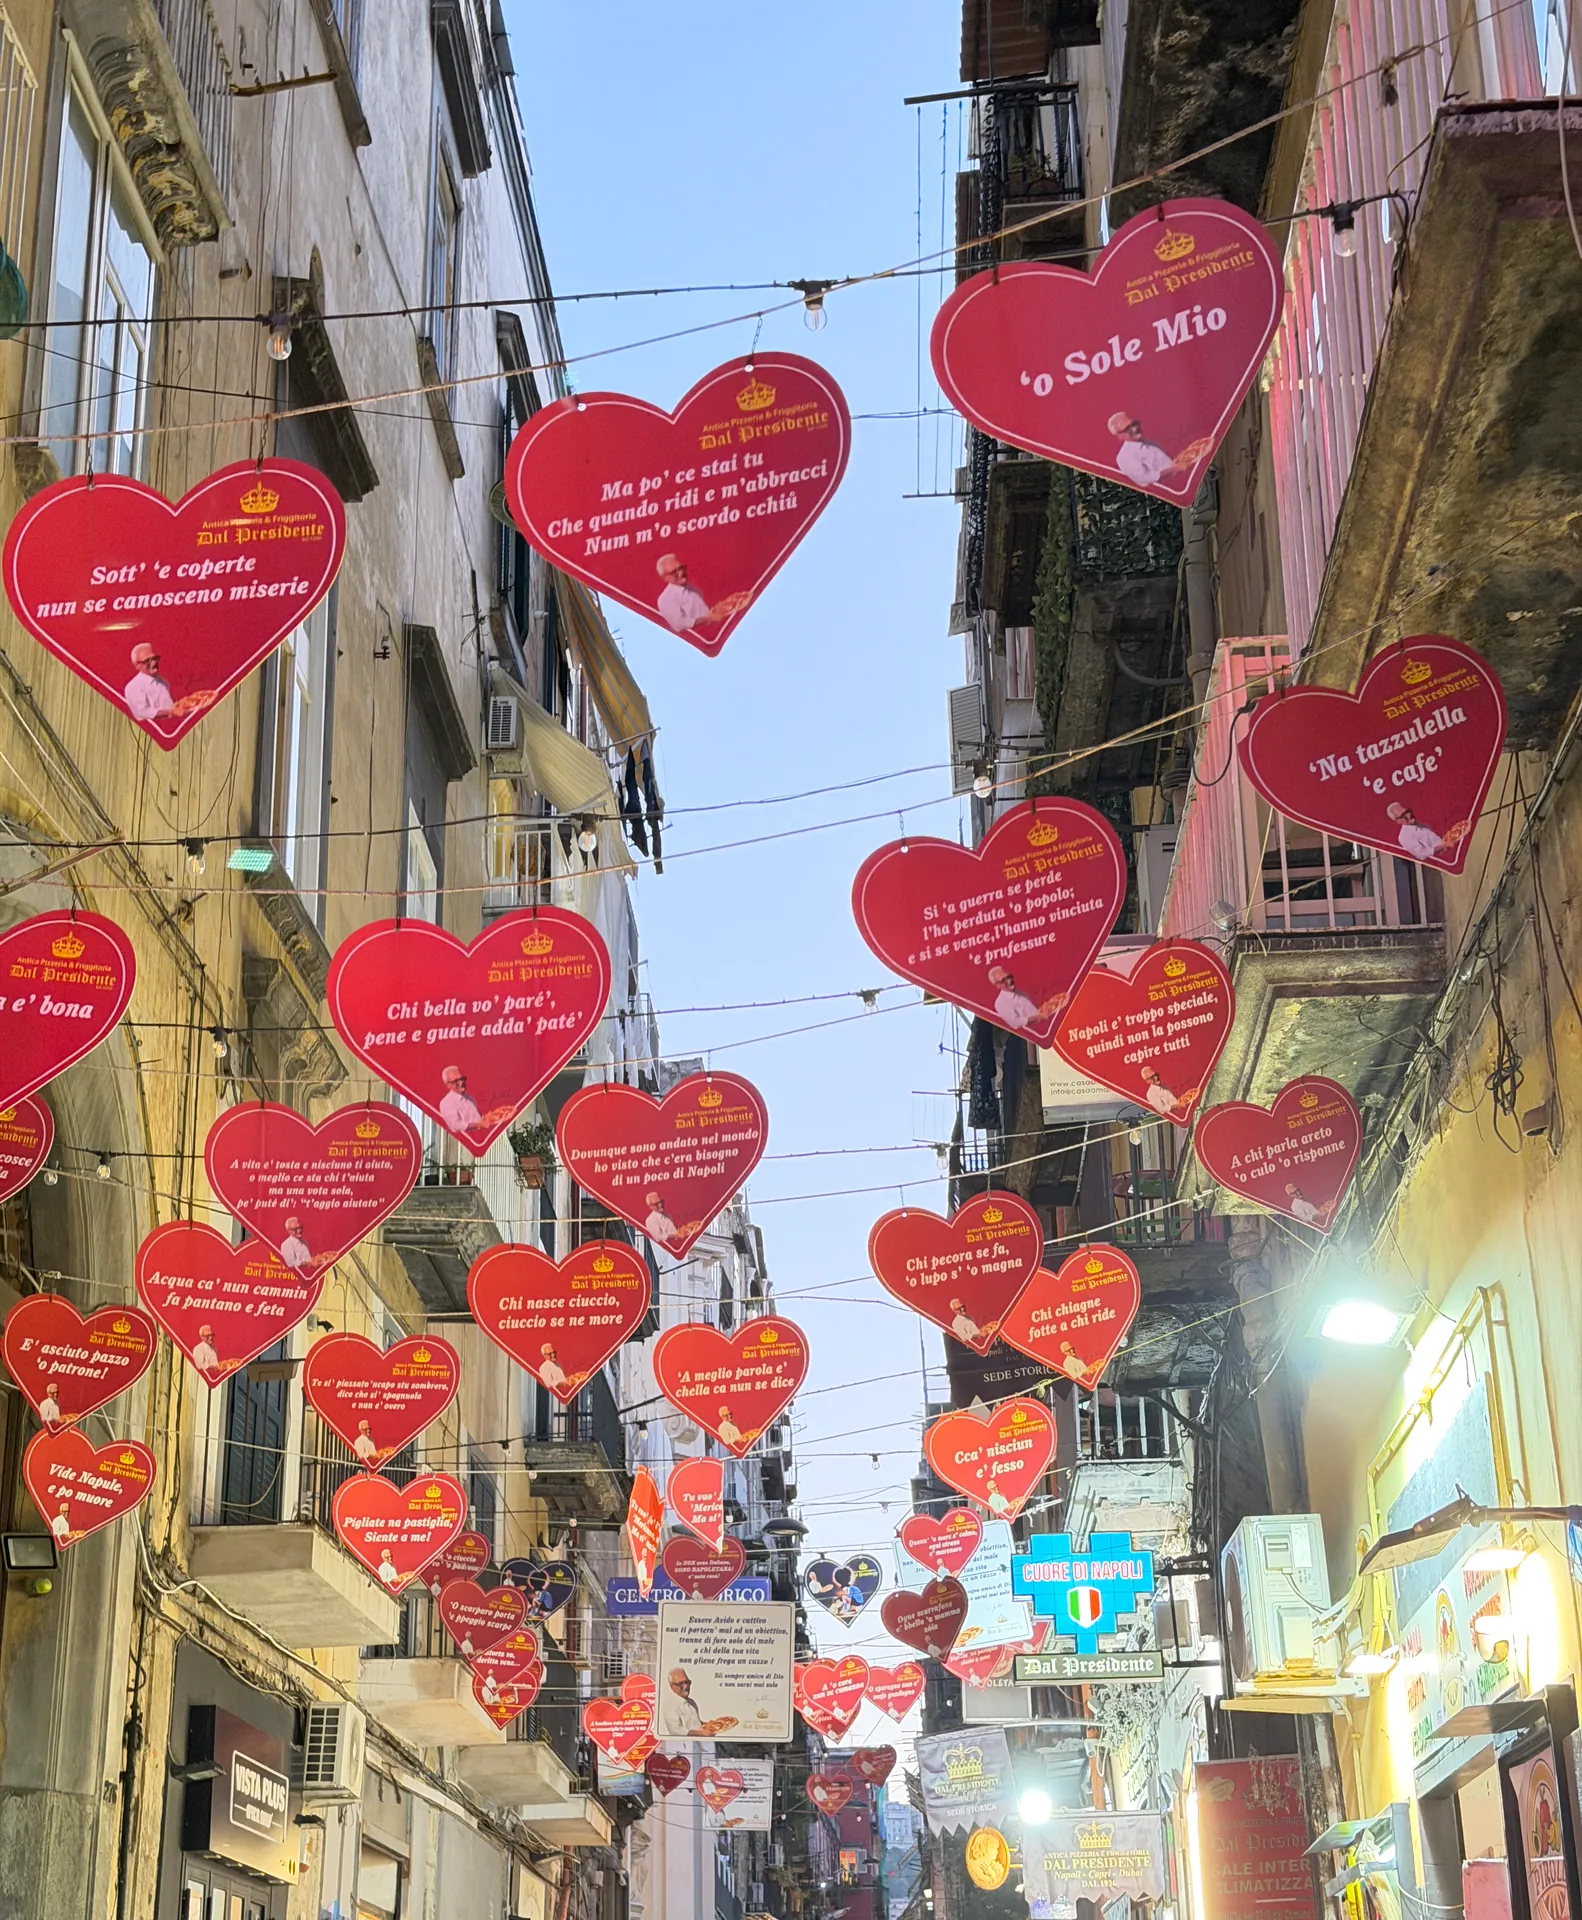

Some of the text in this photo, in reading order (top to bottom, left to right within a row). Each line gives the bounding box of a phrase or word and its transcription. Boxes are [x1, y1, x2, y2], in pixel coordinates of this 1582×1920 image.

[1021, 305, 1226, 396] 'o Sole Mio
[699, 412, 828, 449] Dal Presidente
[601, 453, 763, 502] Ma po' ce stai tu
[548, 459, 827, 538] Che quando ridi e m'abbracci
[584, 492, 797, 556] Num m'o scordo cchiù
[91, 556, 256, 585] Sott' 'e coperte
[37, 576, 309, 618] nun se canosceno miserie
[1310, 706, 1466, 781] 'Na tazzulella
[1364, 747, 1442, 794] 'e cafe'
[12, 994, 94, 1018] e' bona
[388, 1002, 418, 1020] Chi
[424, 998, 466, 1017] bella
[1068, 992, 1218, 1042] Napoli e' troppo speciale,
[363, 1012, 582, 1050] pene e guaie adda' paté'
[1087, 1013, 1214, 1058] quindi non la possono
[1124, 1034, 1190, 1064] capire tutti
[1231, 1128, 1332, 1169] A chi parla areto
[1250, 1164, 1276, 1178] culo
[1294, 1141, 1345, 1164] risponne
[499, 1293, 620, 1310] Chi nasce ciuccio,
[1032, 1298, 1101, 1322] Chi chiagne
[499, 1314, 623, 1329] ciuccio se ne more
[1028, 1308, 1116, 1342] fotte a chi ride
[41, 1344, 89, 1360] asciuto
[89, 1350, 130, 1366] pazzo
[48, 1361, 108, 1379] patrone!
[983, 1366, 1057, 1382] SEDE STORIC
[986, 1439, 1033, 1457] nisciun
[50, 1464, 122, 1494] Vide Napule,
[990, 1460, 1024, 1478] fesso
[48, 1485, 113, 1508] e po muore
[343, 1517, 385, 1529] Pigliate
[403, 1517, 453, 1529] pastiglia,
[364, 1532, 432, 1542] Siente a me!
[1022, 1560, 1143, 1582] CUORE DI NAPOLI
[1024, 1656, 1154, 1676] Dal Presidente
[236, 1763, 286, 1812] VISTA PLUS
[1044, 1857, 1152, 1871] DAL PRESIDENTE
